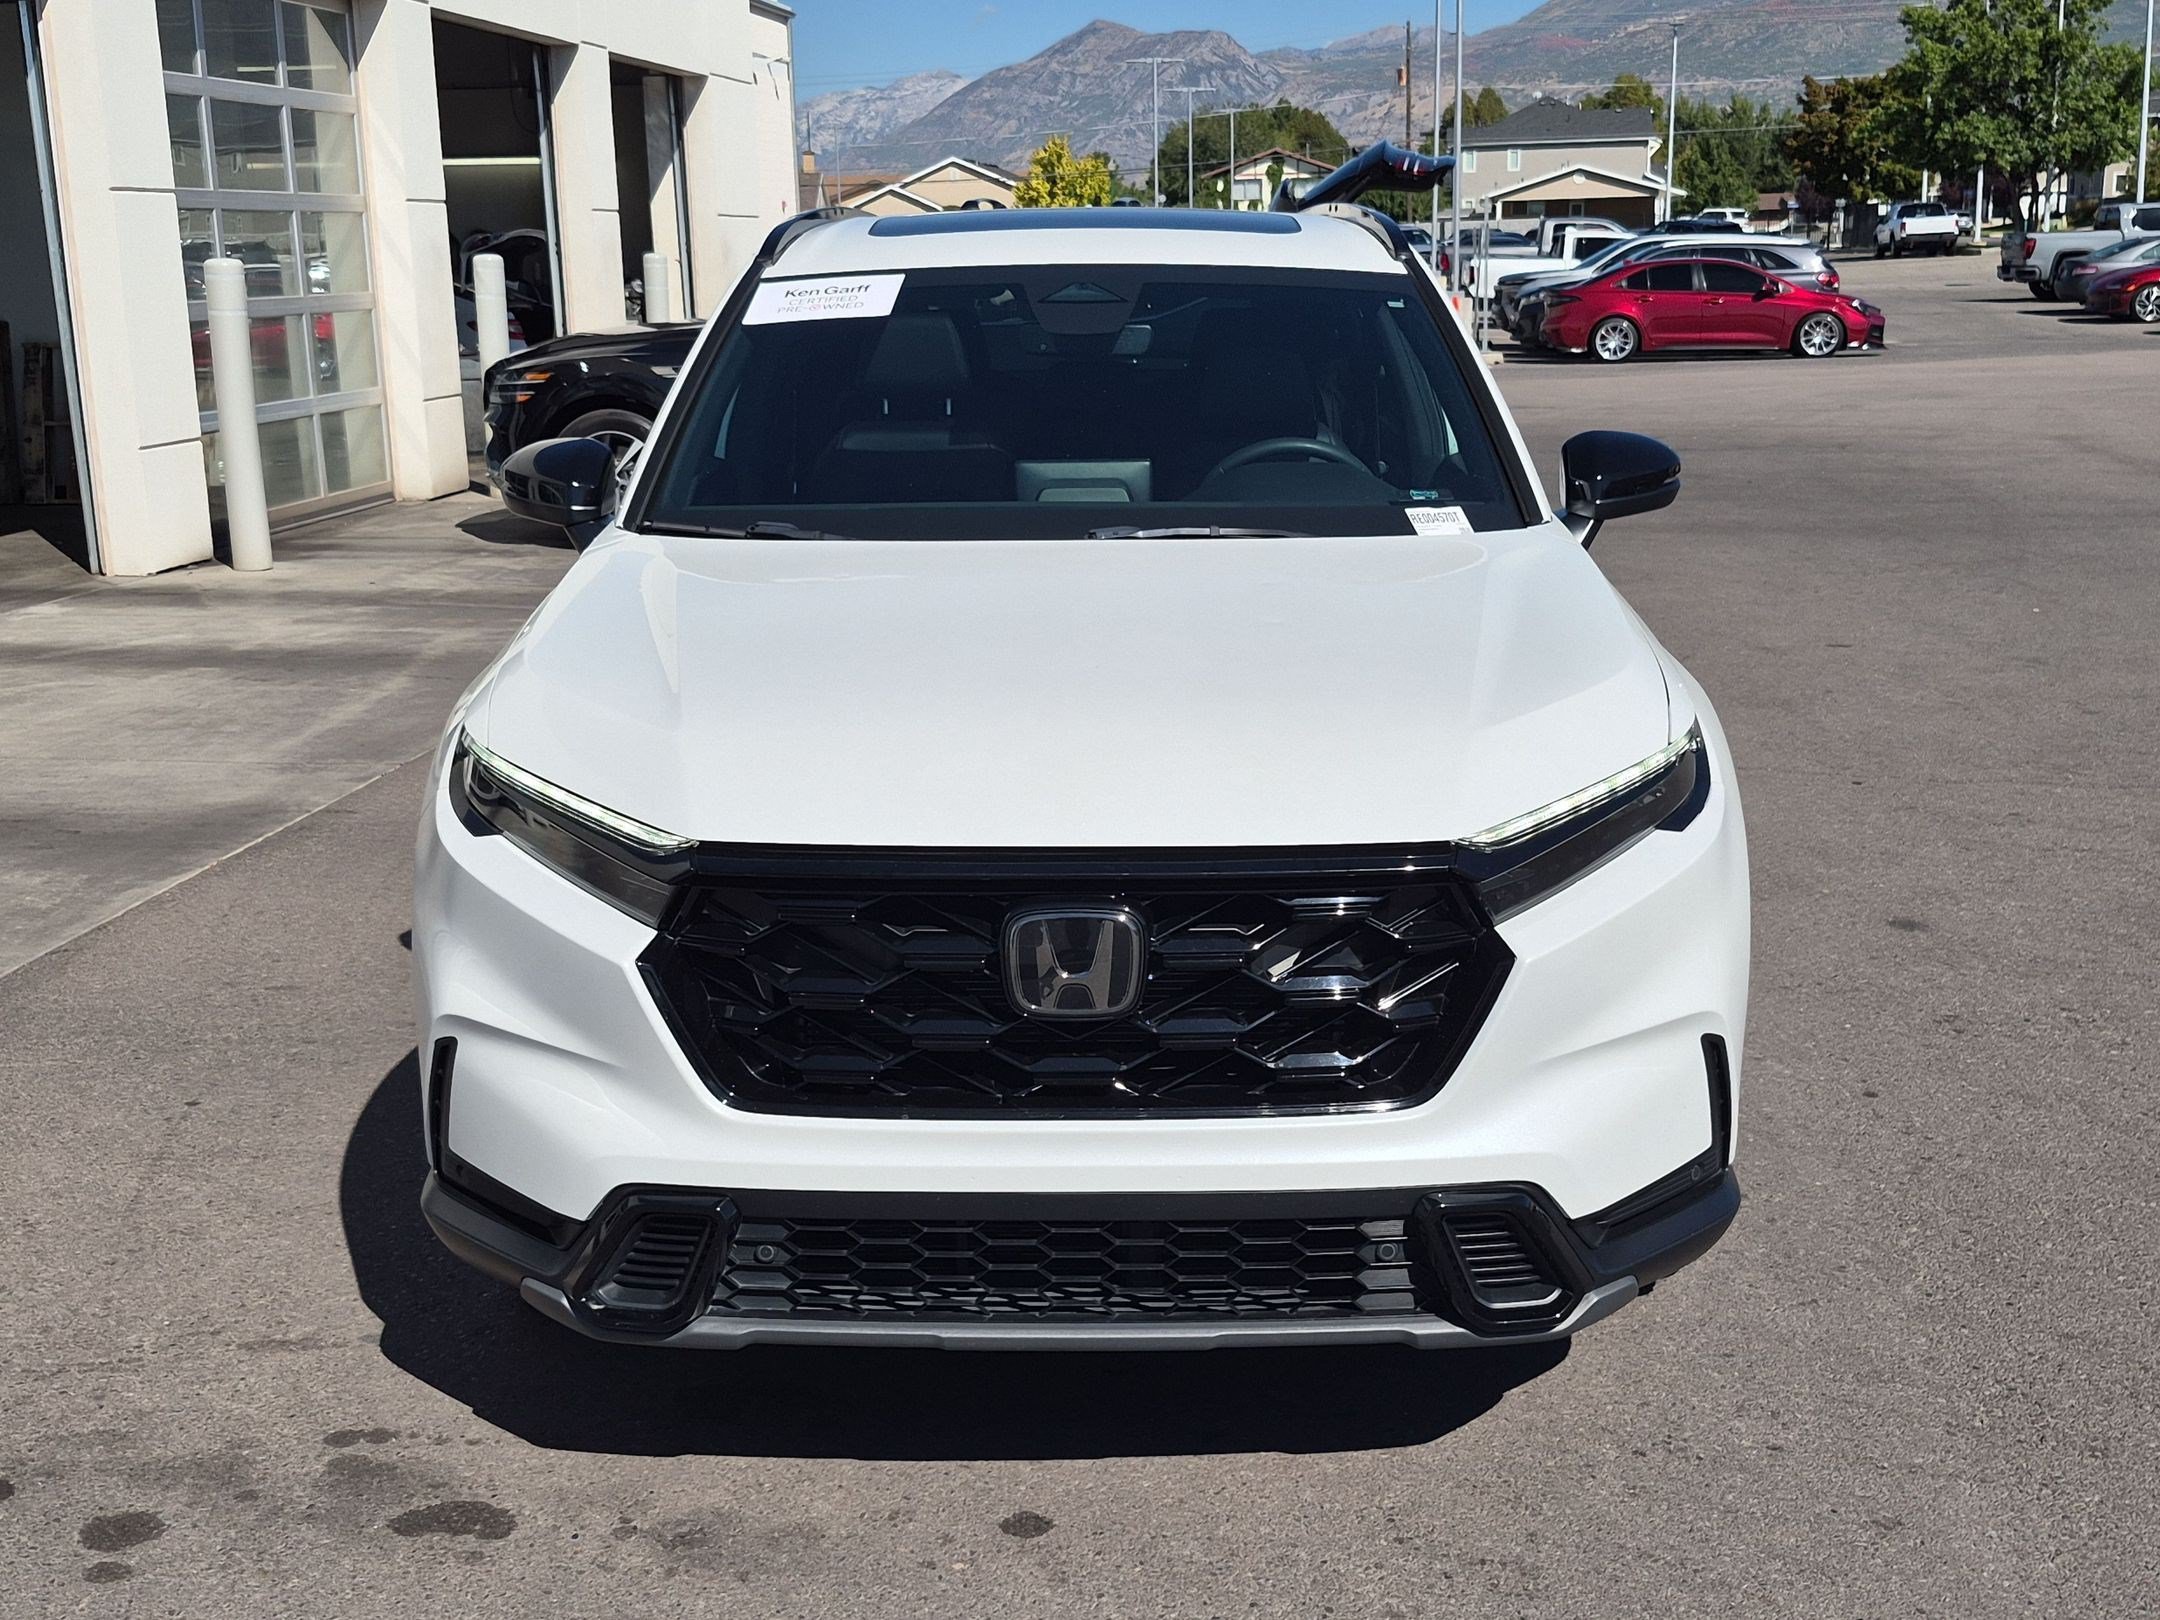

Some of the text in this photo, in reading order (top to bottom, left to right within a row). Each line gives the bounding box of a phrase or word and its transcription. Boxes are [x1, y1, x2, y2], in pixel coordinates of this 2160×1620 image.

[784, 284, 871, 298] Ken Garff
[788, 295, 859, 306] CERTIFIED
[777, 301, 865, 313] PRE-OWNED
